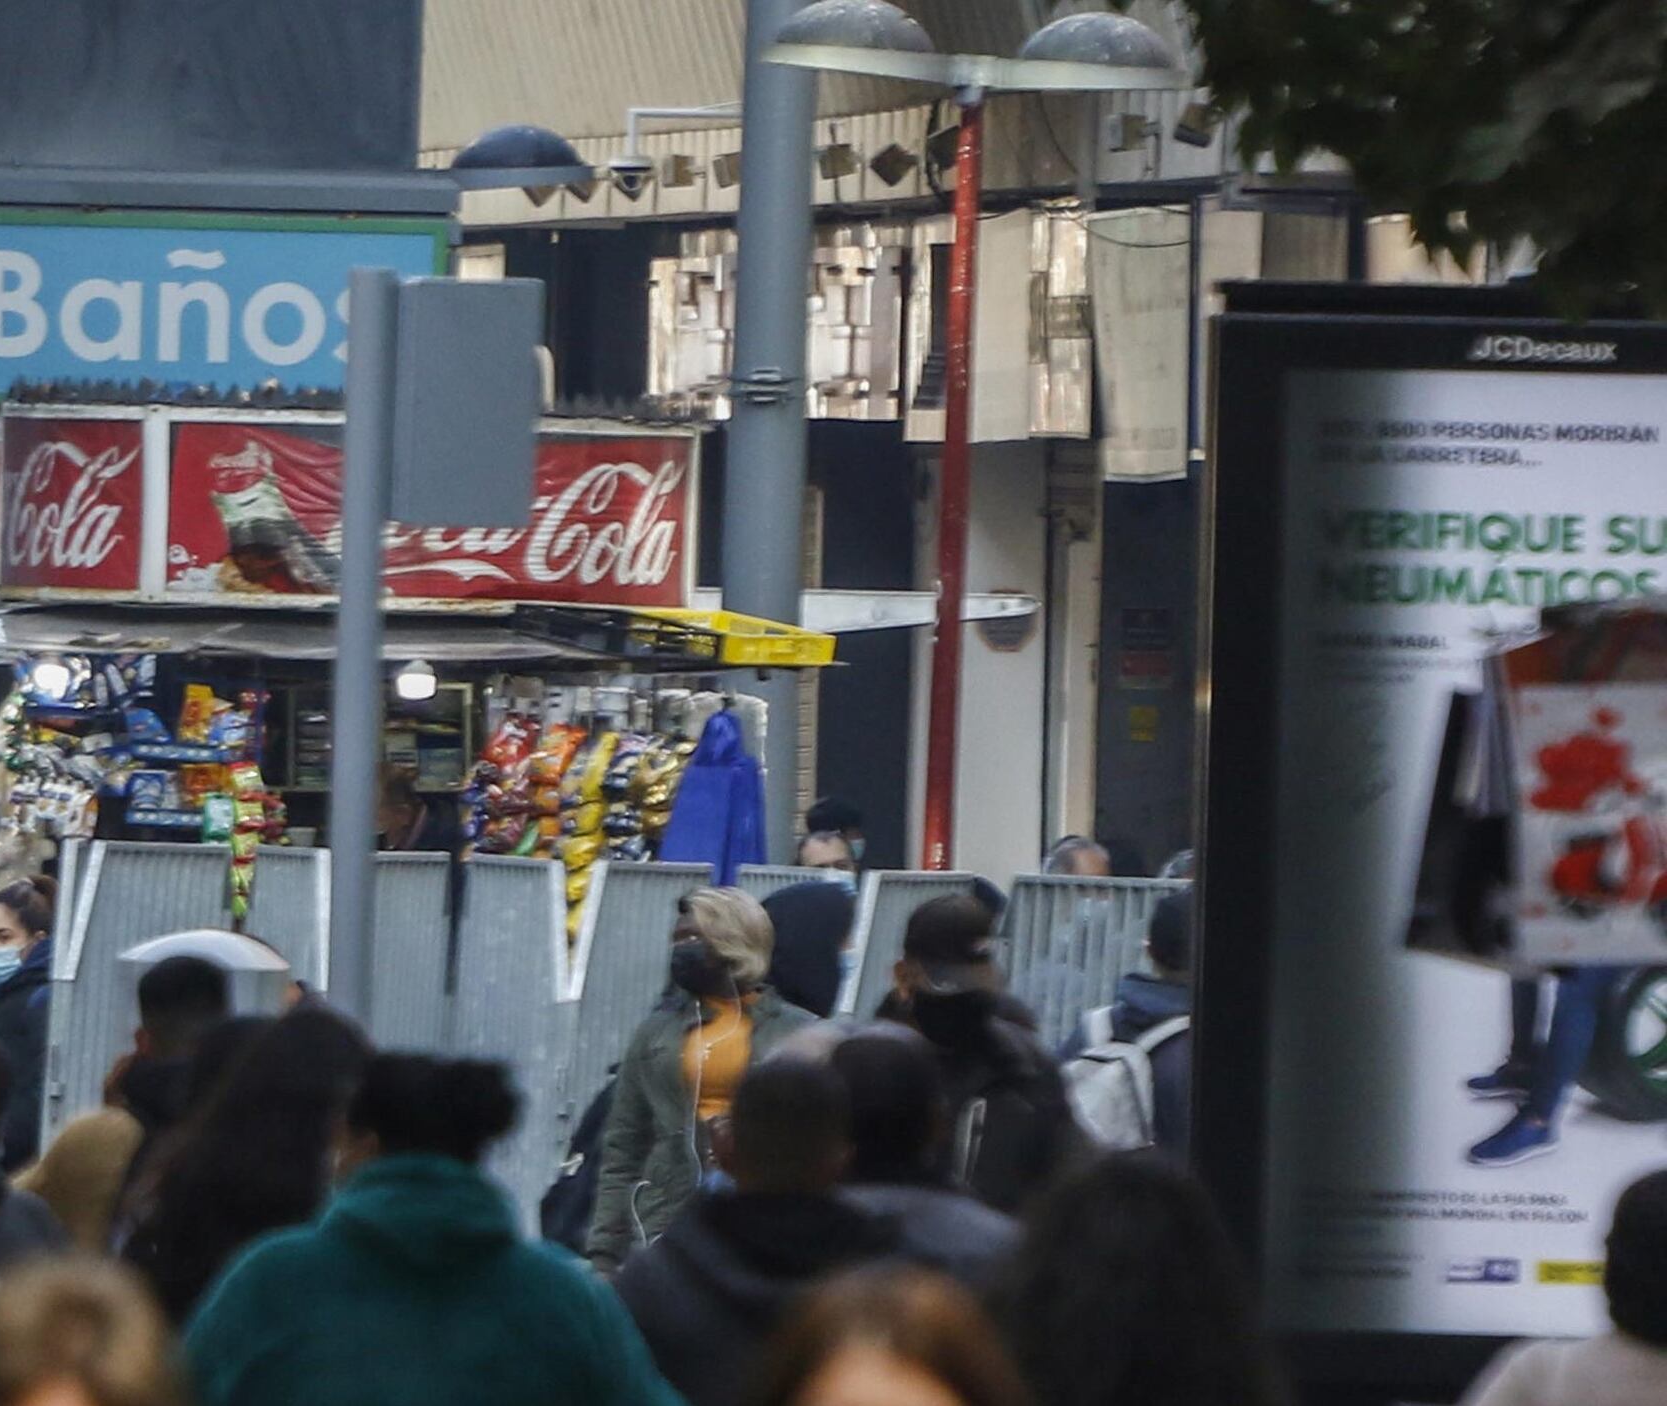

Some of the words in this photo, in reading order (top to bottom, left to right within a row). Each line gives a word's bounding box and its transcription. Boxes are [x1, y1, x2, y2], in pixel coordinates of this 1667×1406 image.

[1473, 334, 1618, 364] JCDecaux
[1432, 421, 1549, 440] PERSONAS
[9, 441, 140, 568] Cola
[1322, 508, 1586, 553] VERIFIQUE
